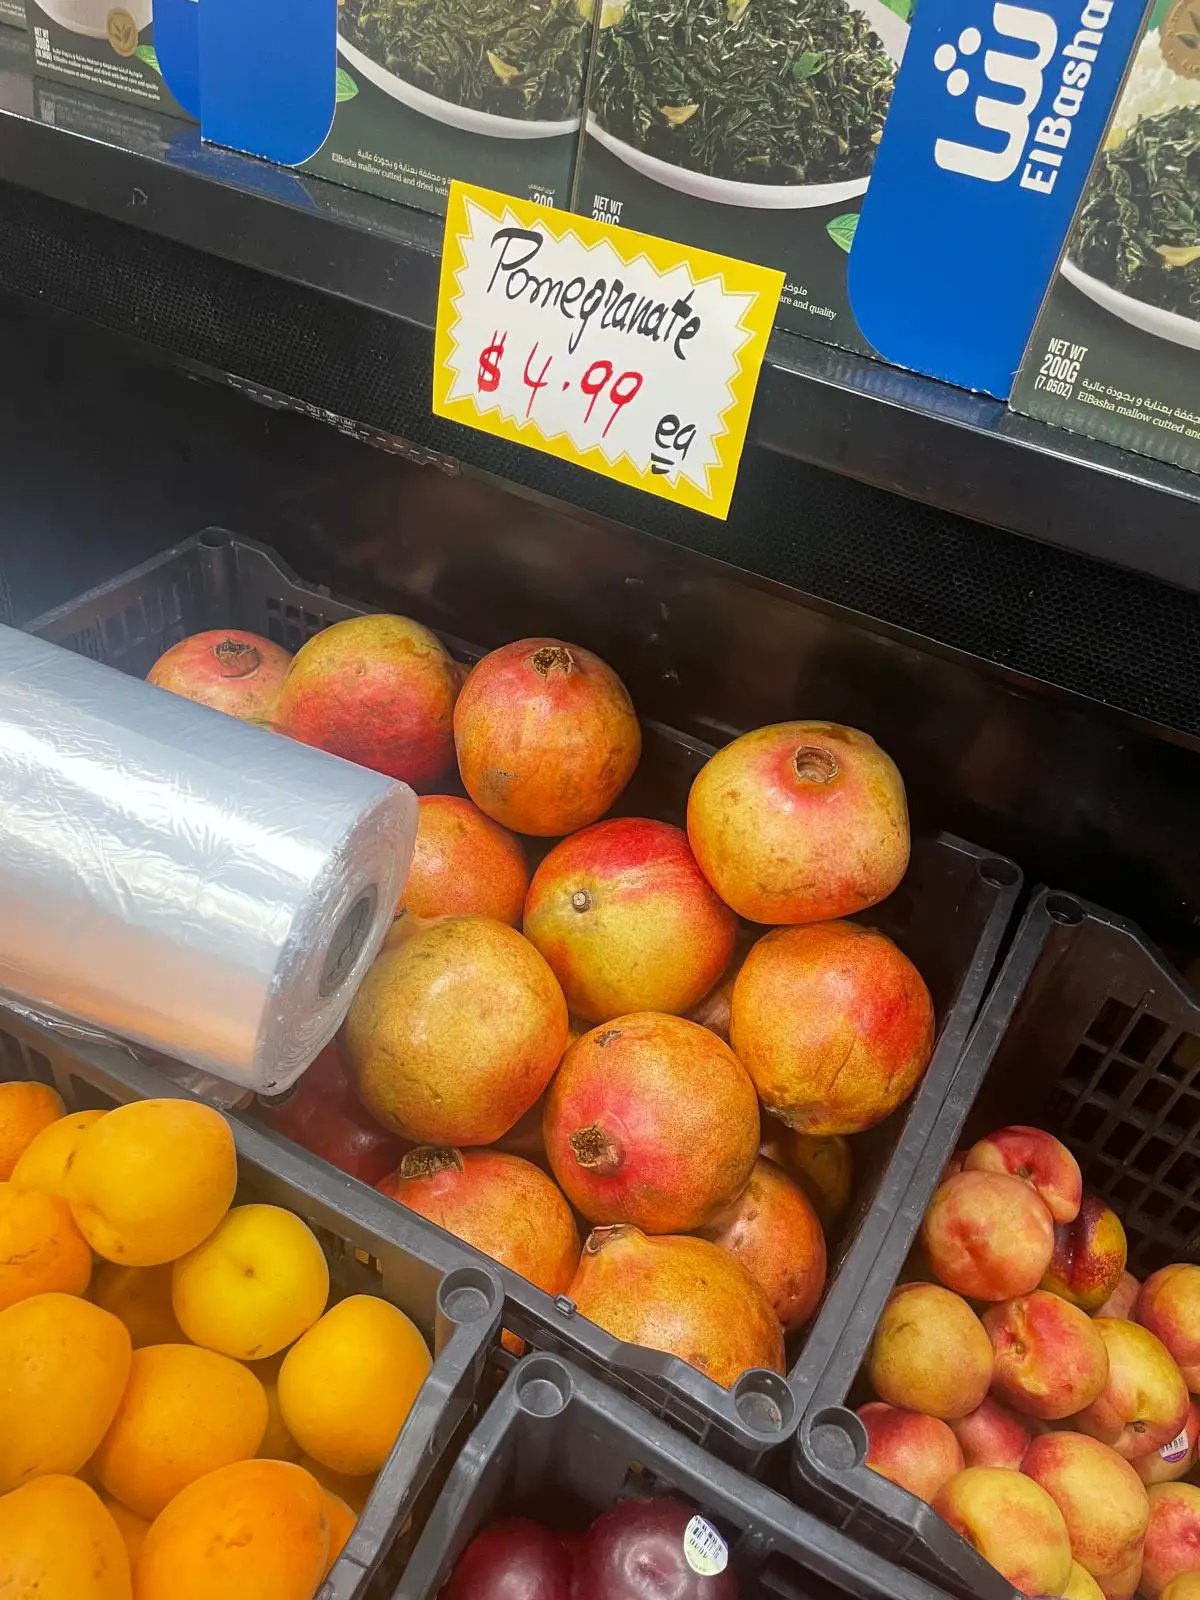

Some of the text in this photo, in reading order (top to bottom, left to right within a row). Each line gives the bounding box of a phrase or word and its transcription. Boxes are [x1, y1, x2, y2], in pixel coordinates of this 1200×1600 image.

[1019, 0, 1114, 195] ElBasha
[331, 152, 357, 168] ElBasha
[358, 162, 381, 177] mallow
[402, 177, 416, 187] and
[416, 179, 434, 192] dried
[434, 185, 449, 197] with
[593, 194, 624, 216] NET WT
[486, 227, 701, 361] Pomegranate
[783, 282, 808, 296] ملوخي
[779, 295, 837, 321] are and quality
[1048, 337, 1089, 362] NET WT
[1039, 353, 1081, 384] 200G
[1081, 378, 1105, 393] عالية
[1106, 385, 1136, 405] بجودة
[1077, 391, 1115, 412] ElBasha
[1116, 405, 1152, 422] mallow
[1152, 417, 1185, 434] cutted
[1143, 397, 1173, 417] بعناية
[655, 413, 696, 461] ea
